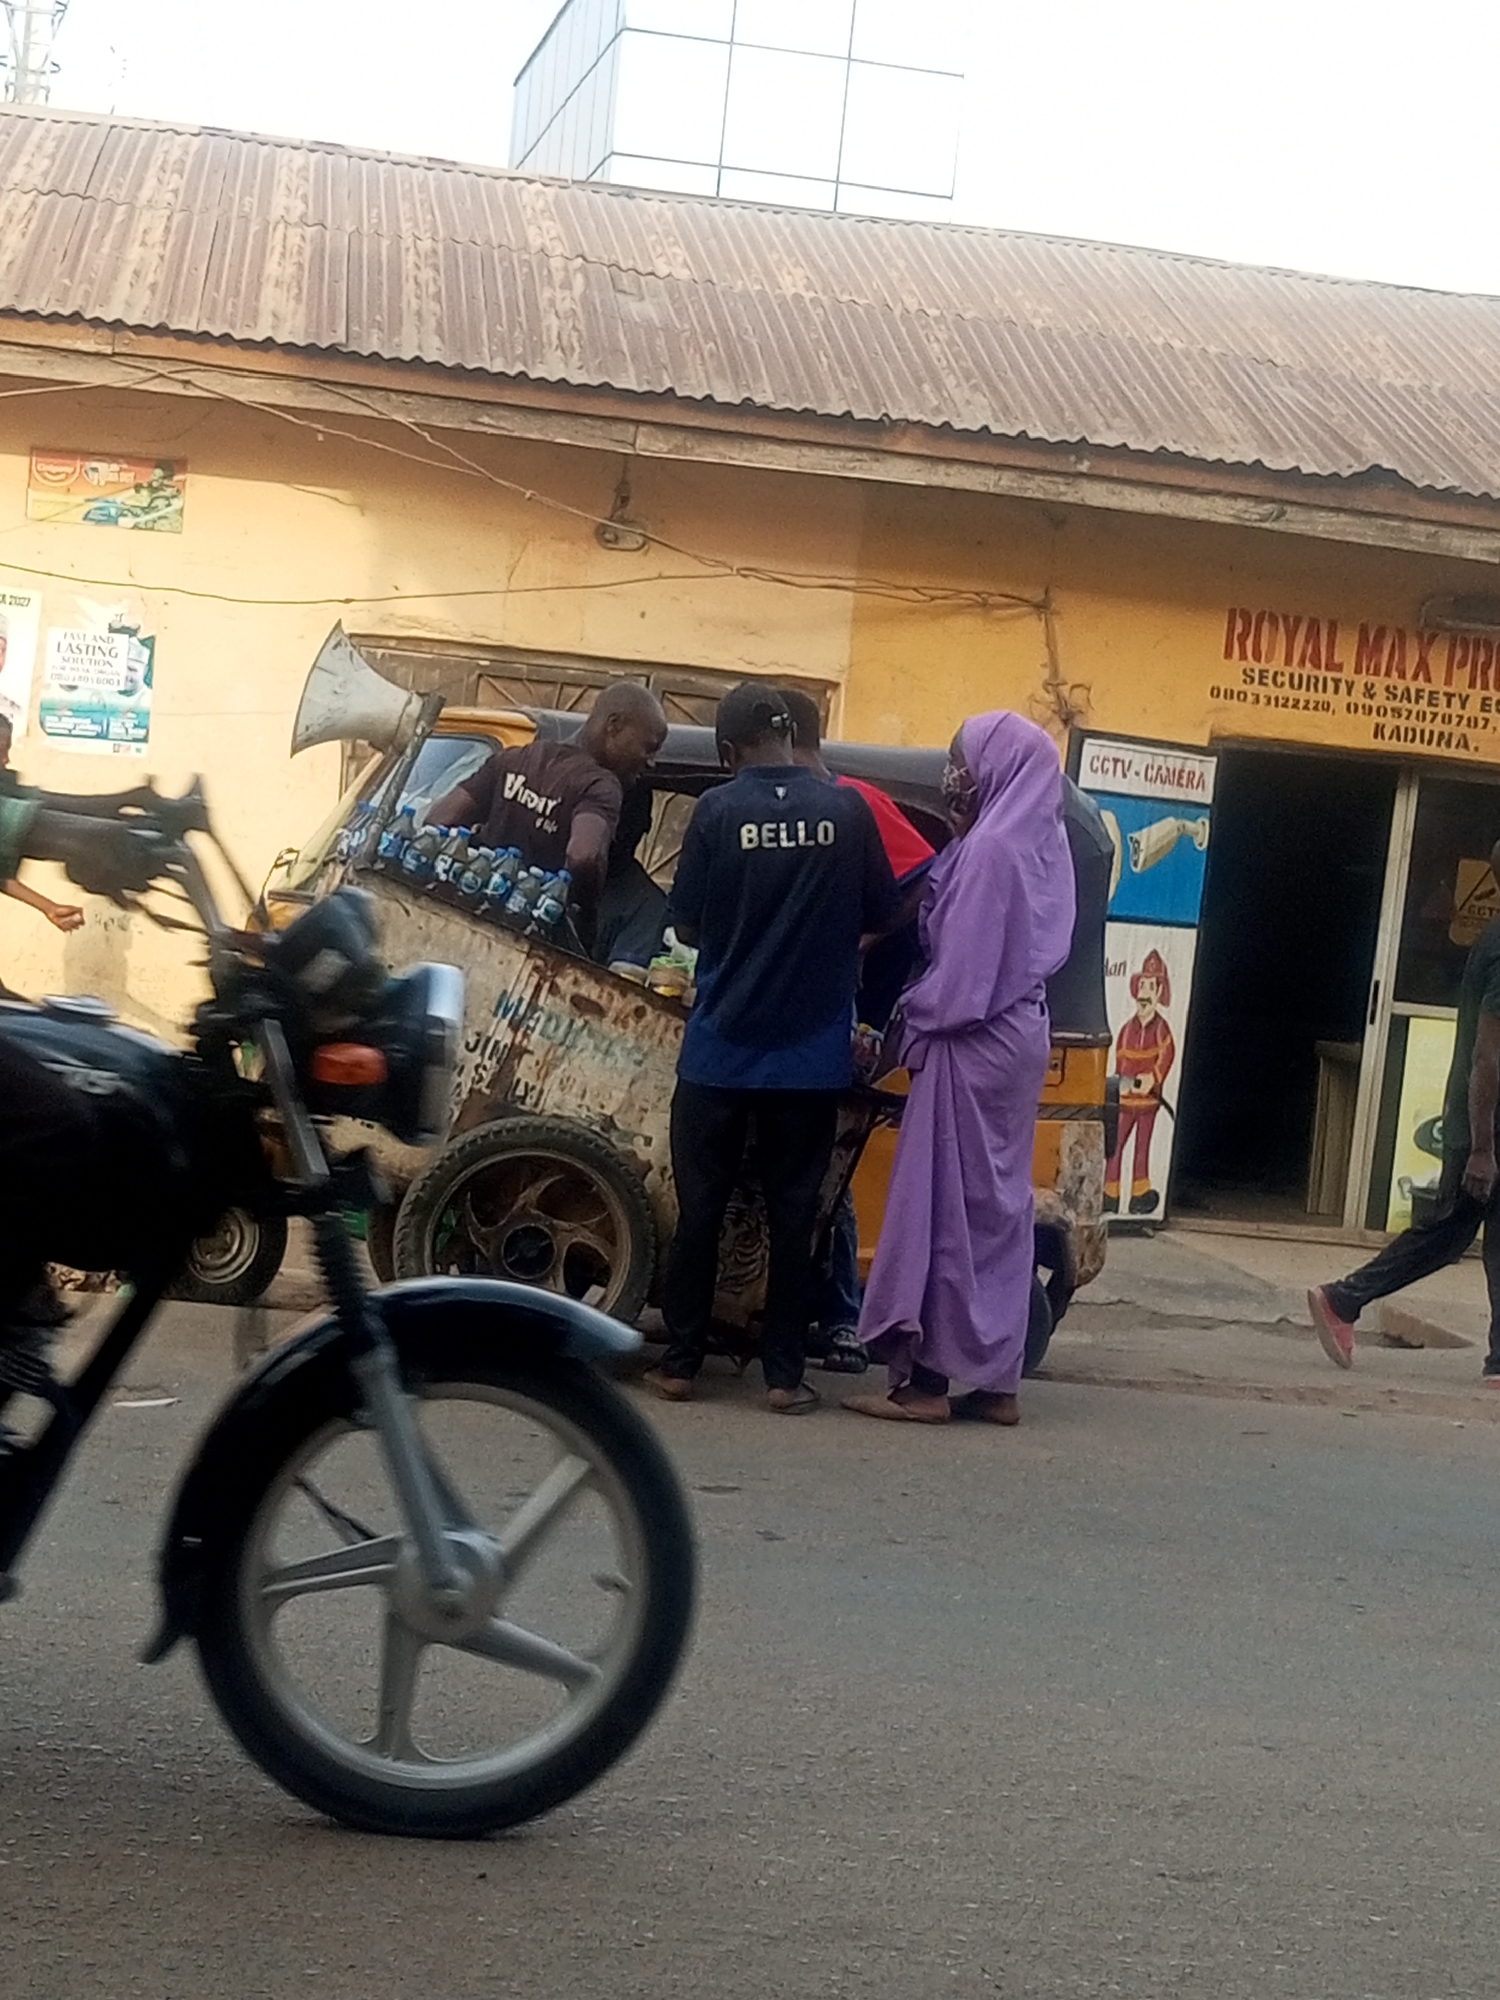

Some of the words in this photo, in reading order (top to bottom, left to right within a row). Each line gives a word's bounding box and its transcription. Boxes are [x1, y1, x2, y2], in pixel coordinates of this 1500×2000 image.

[56, 641, 119, 659] LASTING
[91, 634, 115, 645] AND
[1223, 607, 1344, 673] ROYAL
[1354, 620, 1440, 684] MAX
[1443, 634, 1500, 693] PR
[61, 656, 114, 668] SOLUTION
[1242, 667, 1355, 697] SECURITY
[1362, 681, 1377, 701] &
[1384, 684, 1470, 711] SAFETY
[1373, 722, 1480, 752] KADUNA.
[1089, 754, 1133, 779] CCTV
[1144, 763, 1206, 792] CAMERA
[740, 820, 835, 850] BELLO
